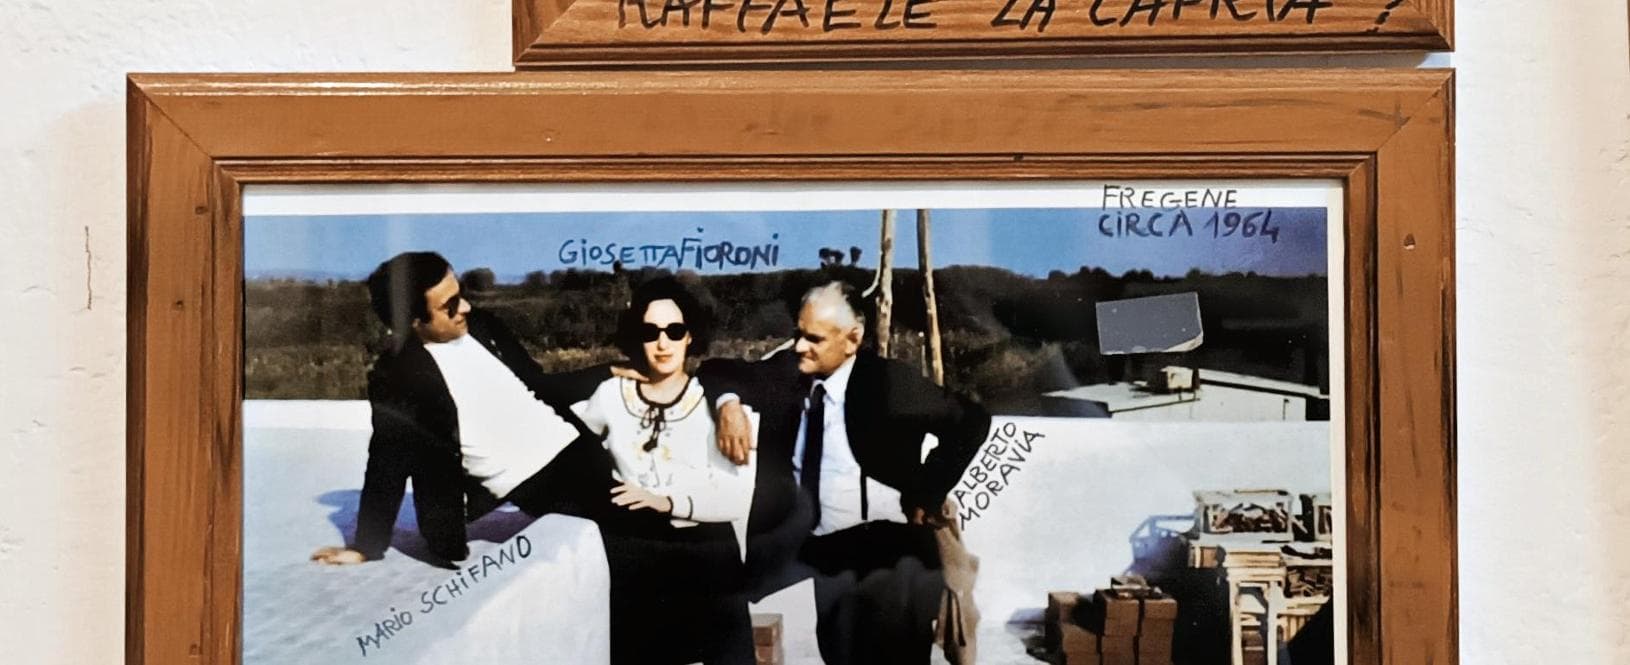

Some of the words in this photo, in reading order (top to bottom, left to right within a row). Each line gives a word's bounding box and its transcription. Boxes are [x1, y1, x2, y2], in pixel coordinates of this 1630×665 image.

[990, 0, 1056, 32] LA
[1103, 184, 1238, 211] FREGENE
[1203, 207, 1280, 243] 1964
[953, 422, 1016, 509] ALBERTO
